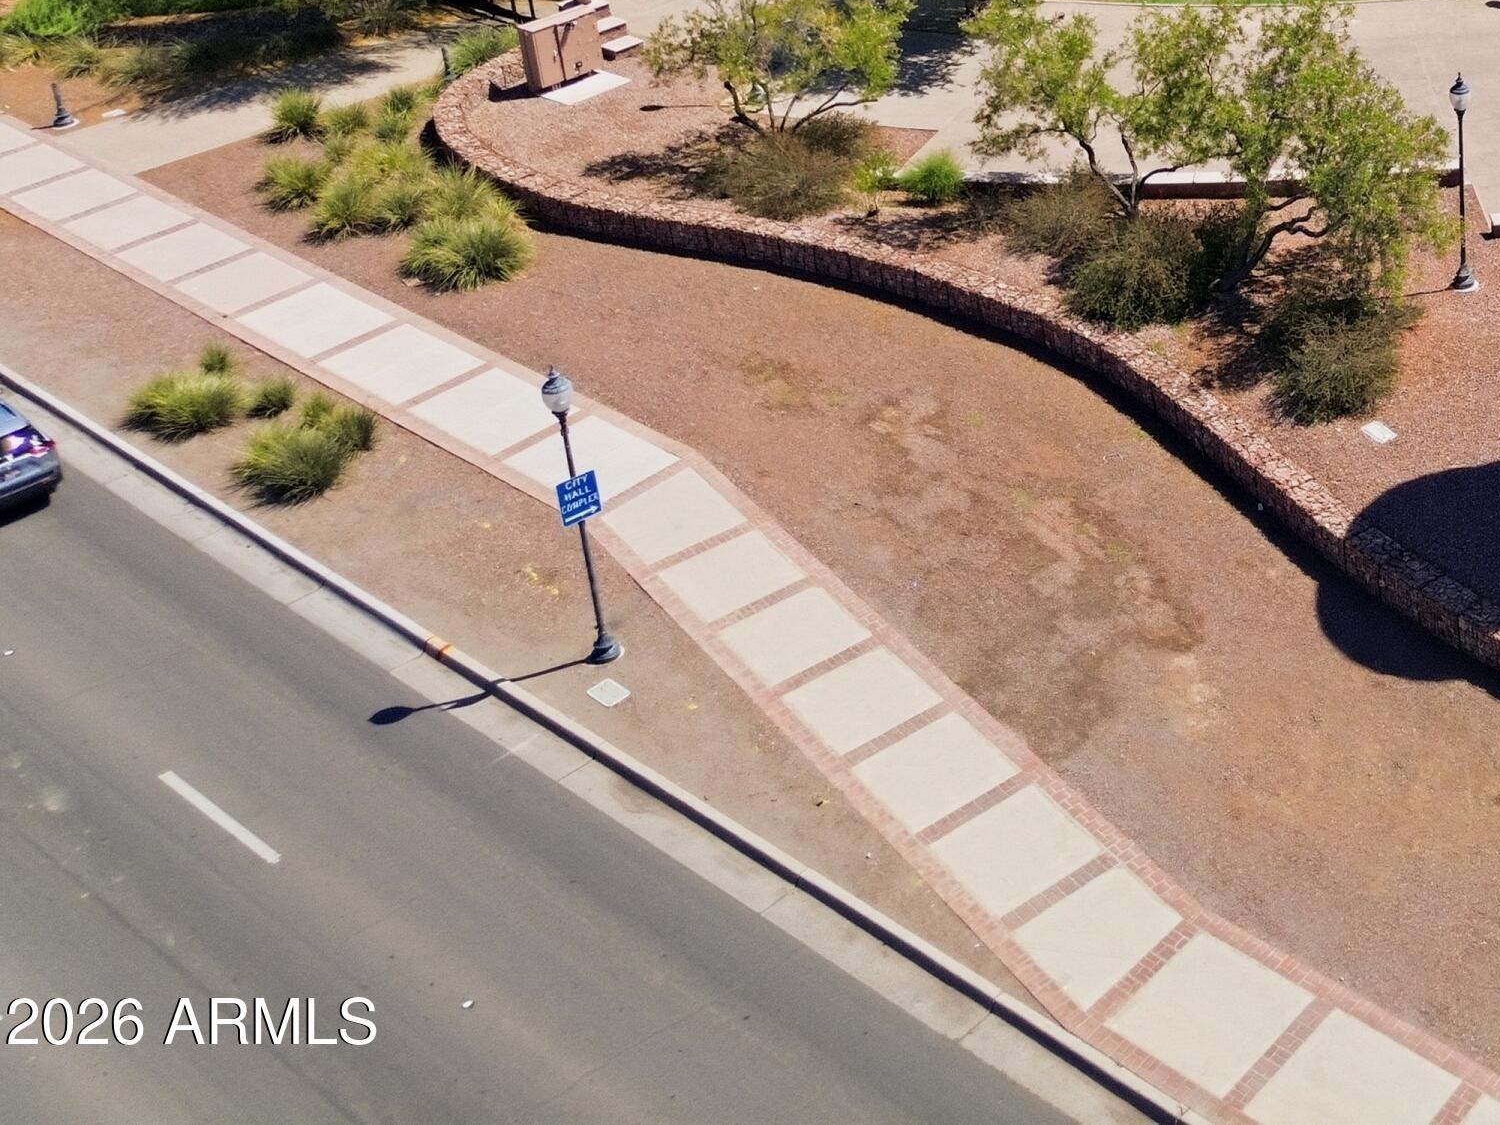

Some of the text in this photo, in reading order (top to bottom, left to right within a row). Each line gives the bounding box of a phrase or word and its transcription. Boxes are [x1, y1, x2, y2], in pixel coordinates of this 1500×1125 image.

[565, 475, 588, 490] CITY
[564, 485, 592, 501] HALL
[561, 492, 598, 515] COMPLEX
